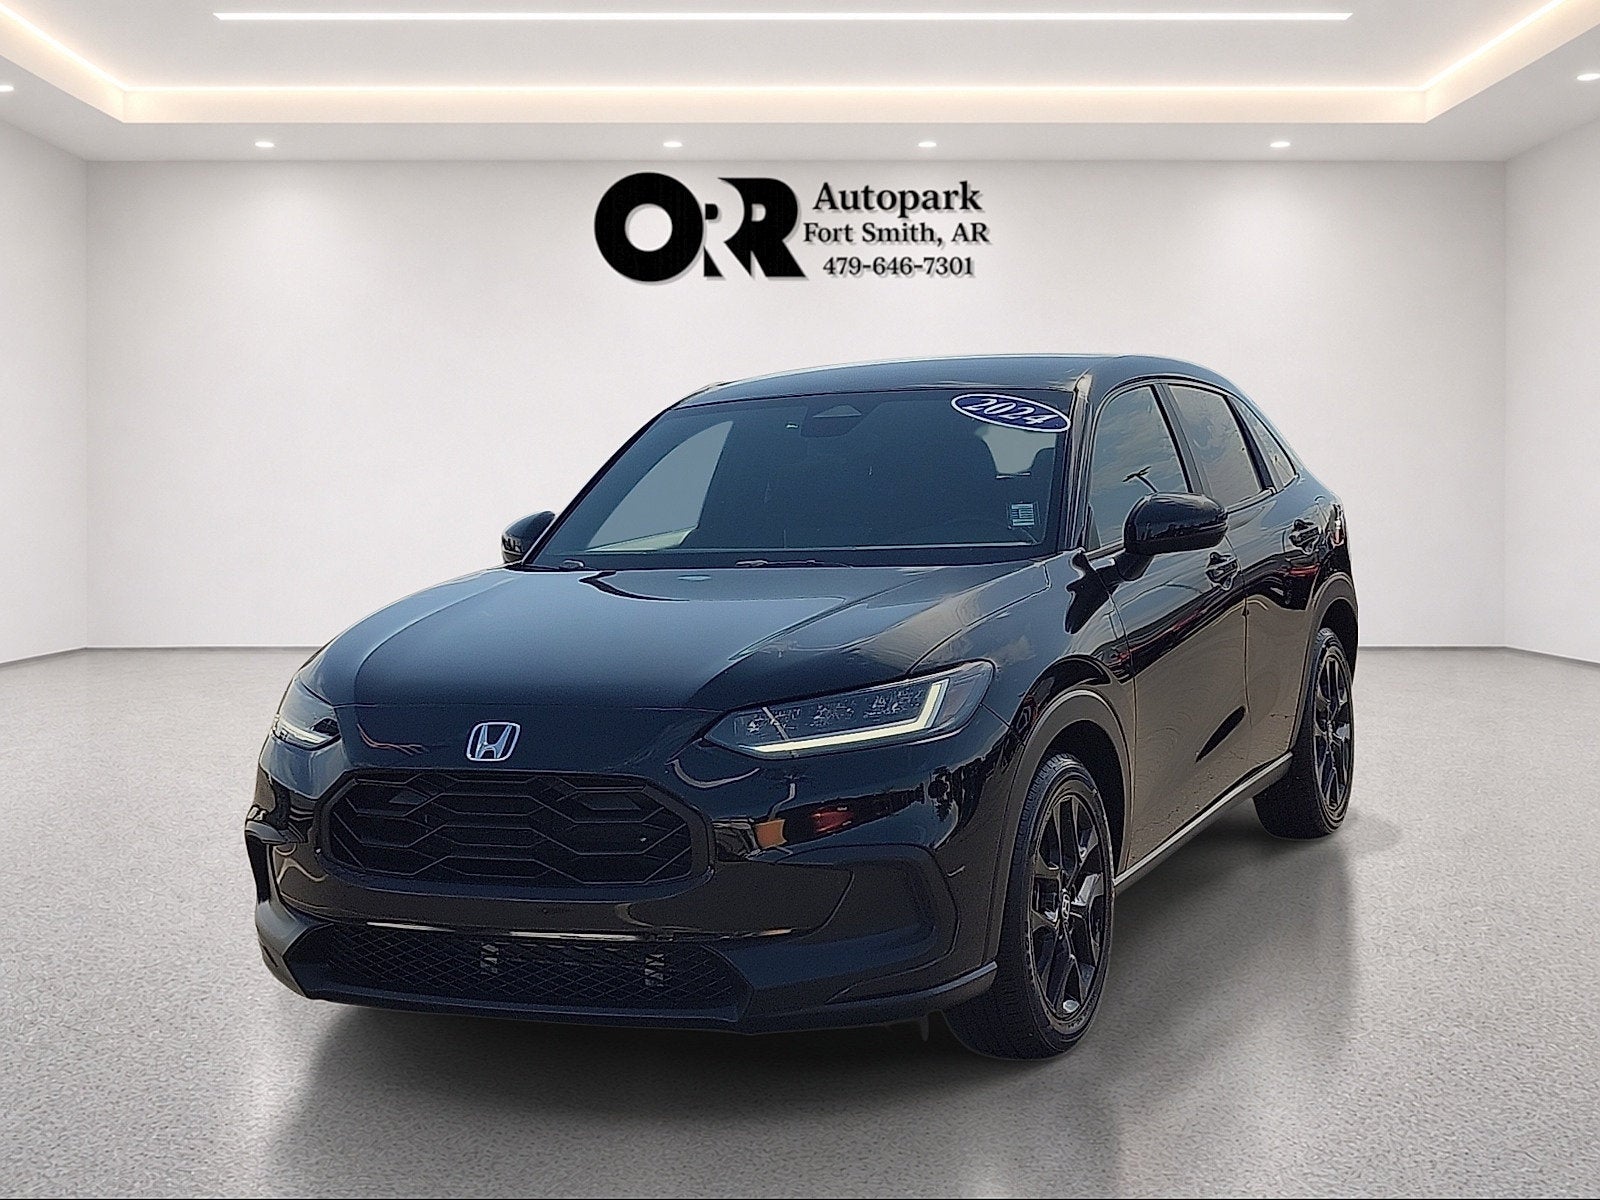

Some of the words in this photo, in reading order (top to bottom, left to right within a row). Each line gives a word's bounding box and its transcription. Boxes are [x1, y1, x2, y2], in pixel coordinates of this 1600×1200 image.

[813, 181, 982, 218] Autopark
[594, 172, 806, 282] ORR
[803, 222, 854, 243] Fort
[861, 222, 944, 247] Smith,
[951, 222, 990, 243] AR
[823, 256, 974, 277] 479-646-7301
[962, 398, 1058, 425] 2024
